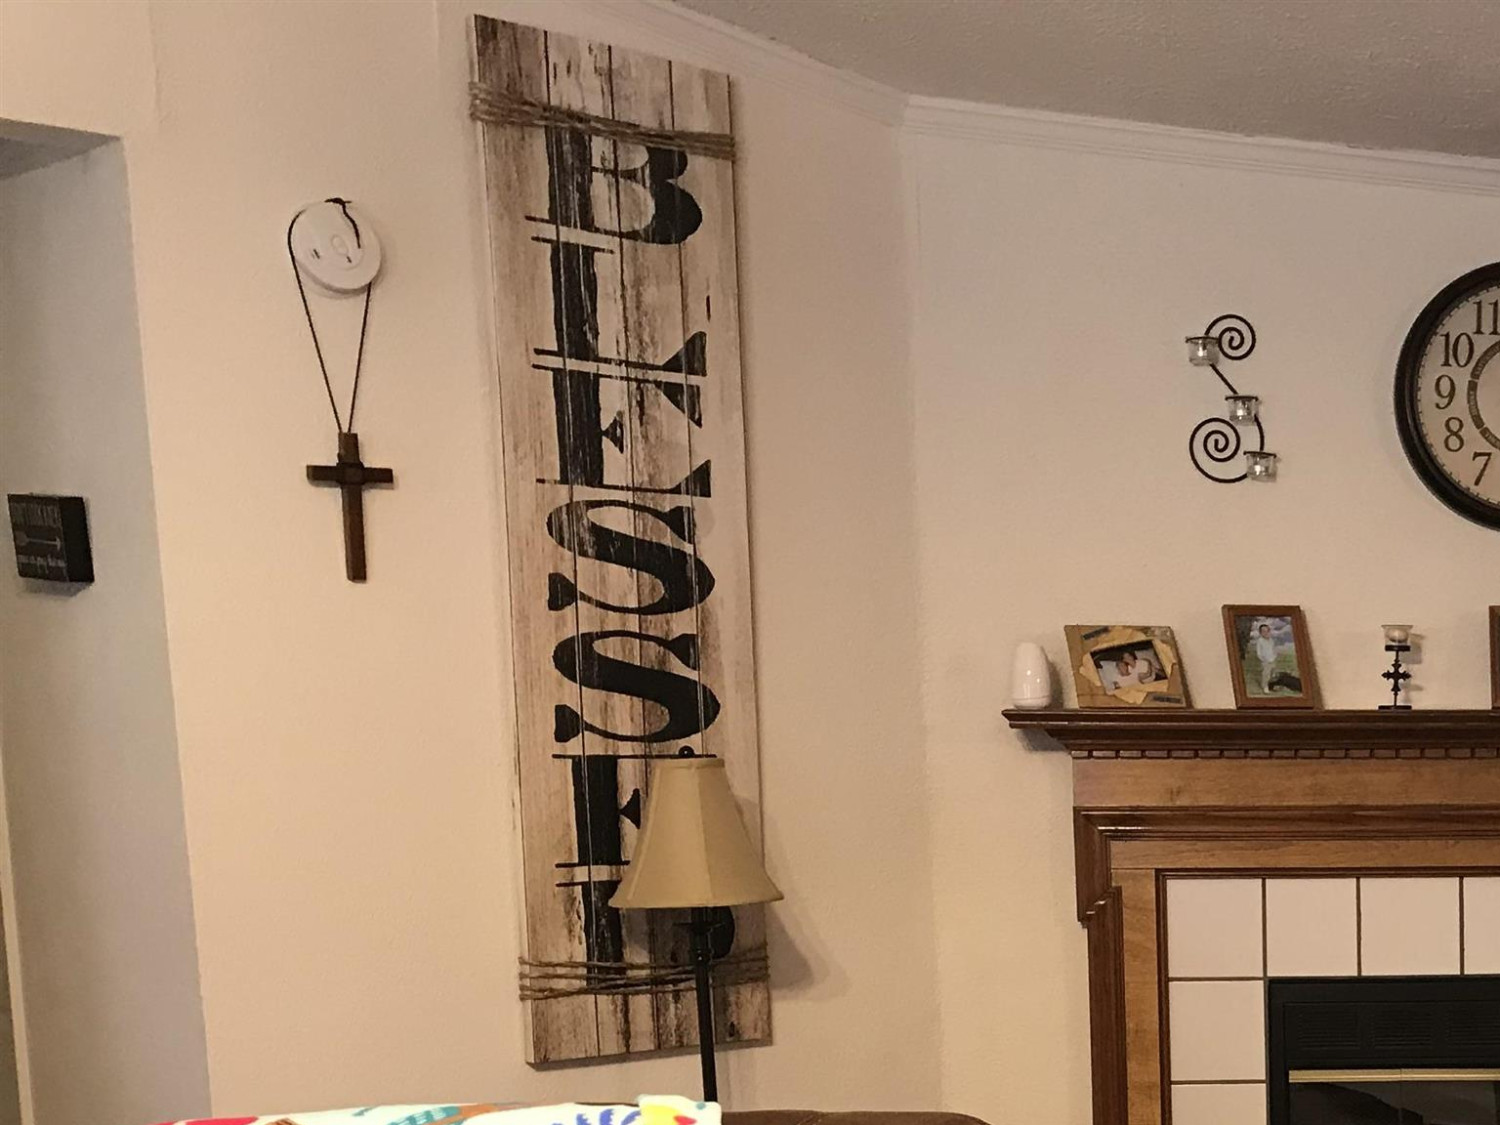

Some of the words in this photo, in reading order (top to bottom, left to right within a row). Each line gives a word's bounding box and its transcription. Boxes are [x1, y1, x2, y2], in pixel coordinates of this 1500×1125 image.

[1473, 300, 1500, 335] 11
[1440, 332, 1474, 367] 10
[1435, 375, 1455, 409] 9
[1444, 417, 1464, 451] 8
[1472, 452, 1492, 486] 7
